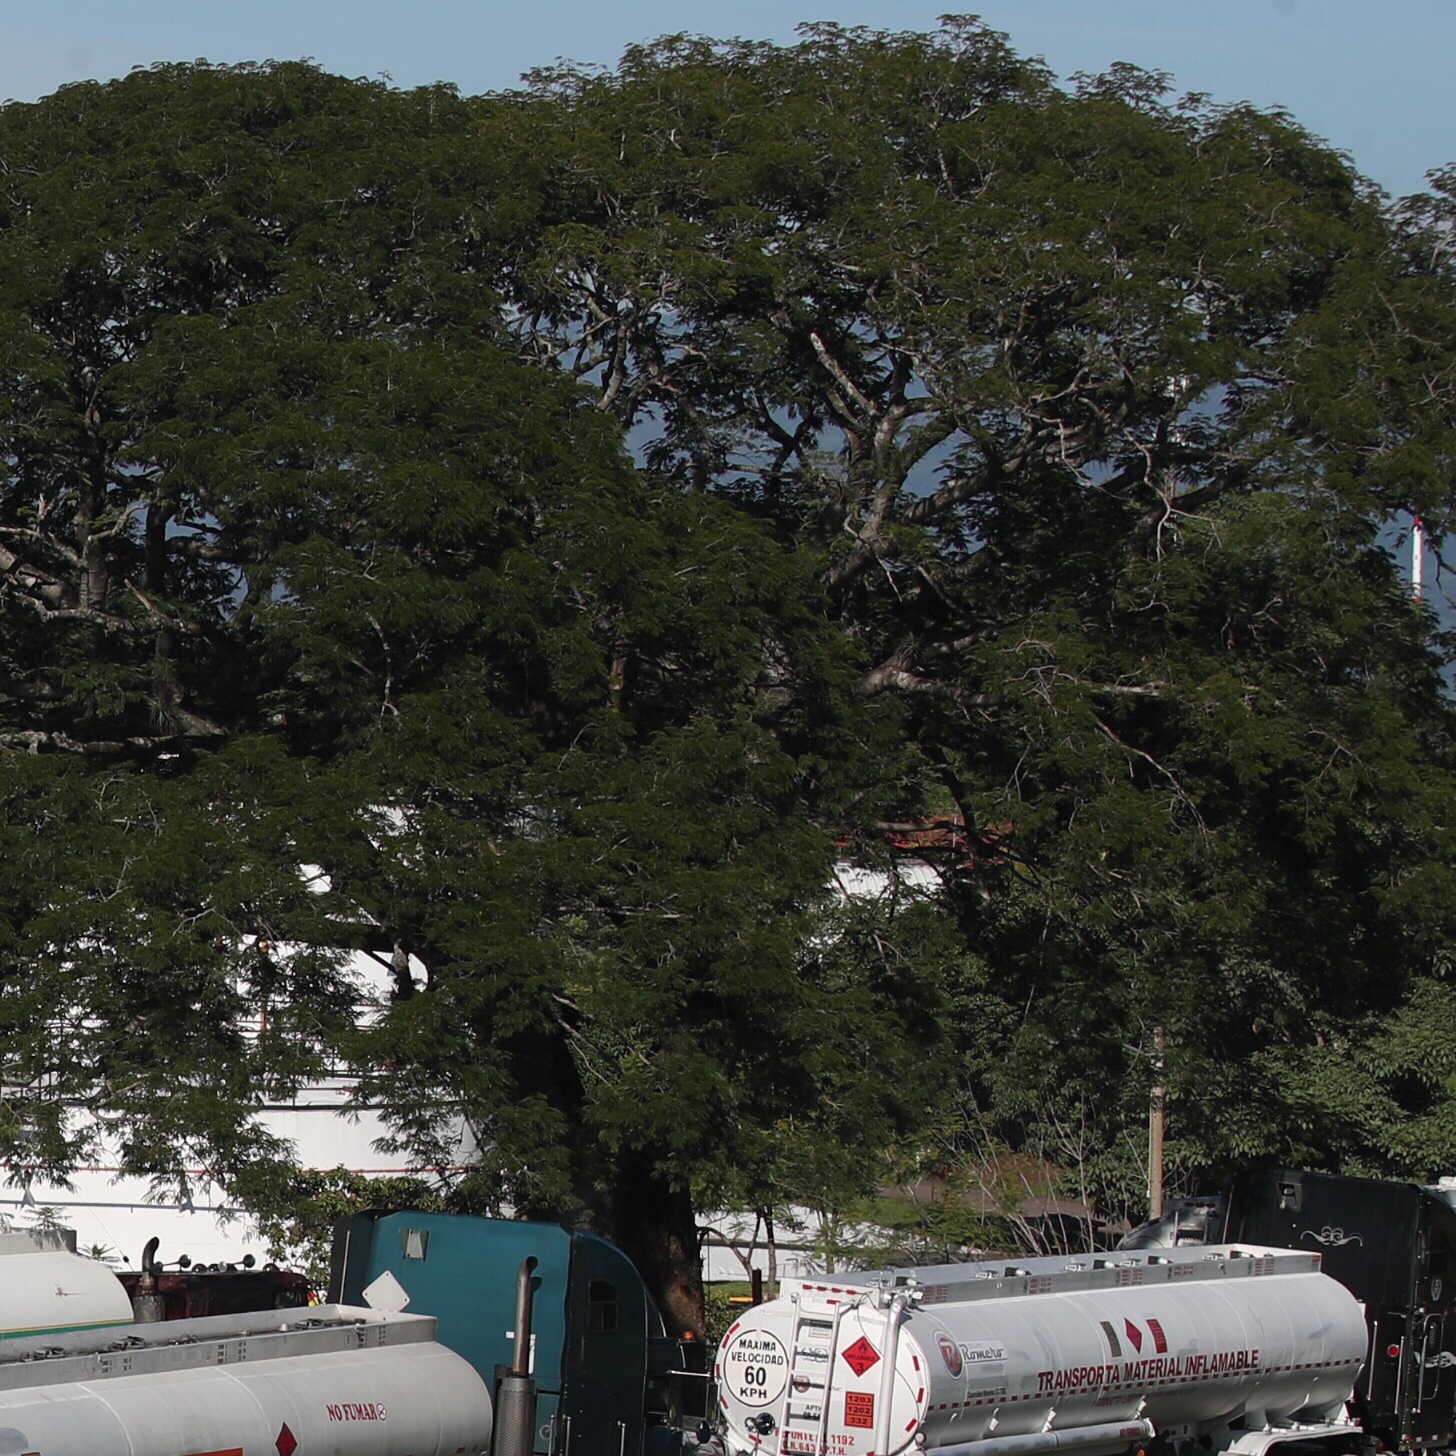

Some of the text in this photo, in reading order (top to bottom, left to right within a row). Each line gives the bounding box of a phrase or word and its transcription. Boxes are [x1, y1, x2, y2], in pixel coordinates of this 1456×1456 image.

[738, 1339, 777, 1352] MAXIMA
[958, 1343, 1004, 1361] Romero
[731, 1351, 784, 1366] VELOCIDAD
[857, 1363, 864, 1373] 3
[1037, 1349, 1259, 1392] TRANSPORTA MATERIAL INFLAMABLE
[744, 1367, 767, 1386] 60
[739, 1387, 768, 1399] KPH
[848, 1395, 871, 1404] 1203
[326, 1402, 378, 1421] NO FUMAR
[847, 1405, 871, 1415] 1202
[850, 1416, 868, 1425] 332
[830, 1434, 855, 1446] 1192
